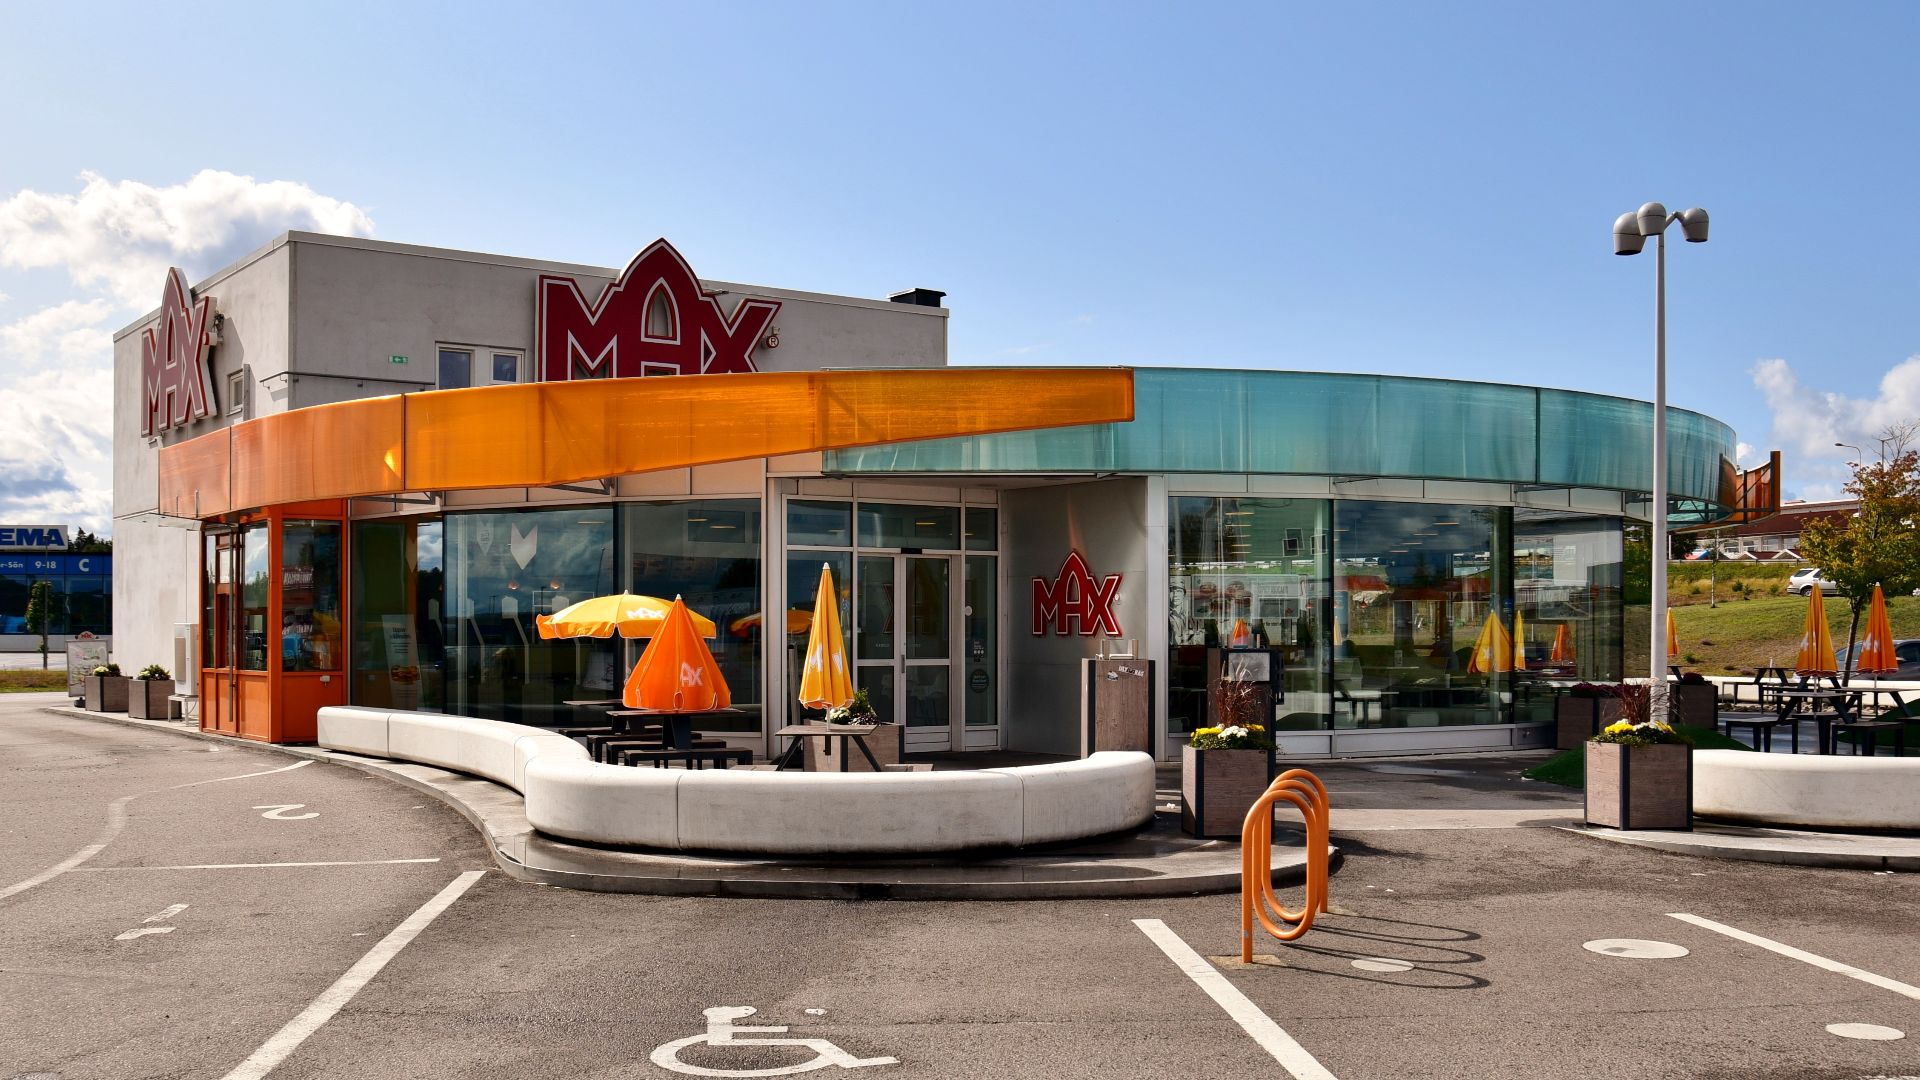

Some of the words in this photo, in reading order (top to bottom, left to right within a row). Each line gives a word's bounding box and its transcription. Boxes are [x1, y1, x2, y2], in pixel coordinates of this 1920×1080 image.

[141, 267, 211, 437] MAX
[535, 238, 782, 382] MAX
[79, 558, 89, 572] C
[1032, 551, 1122, 636] MAX
